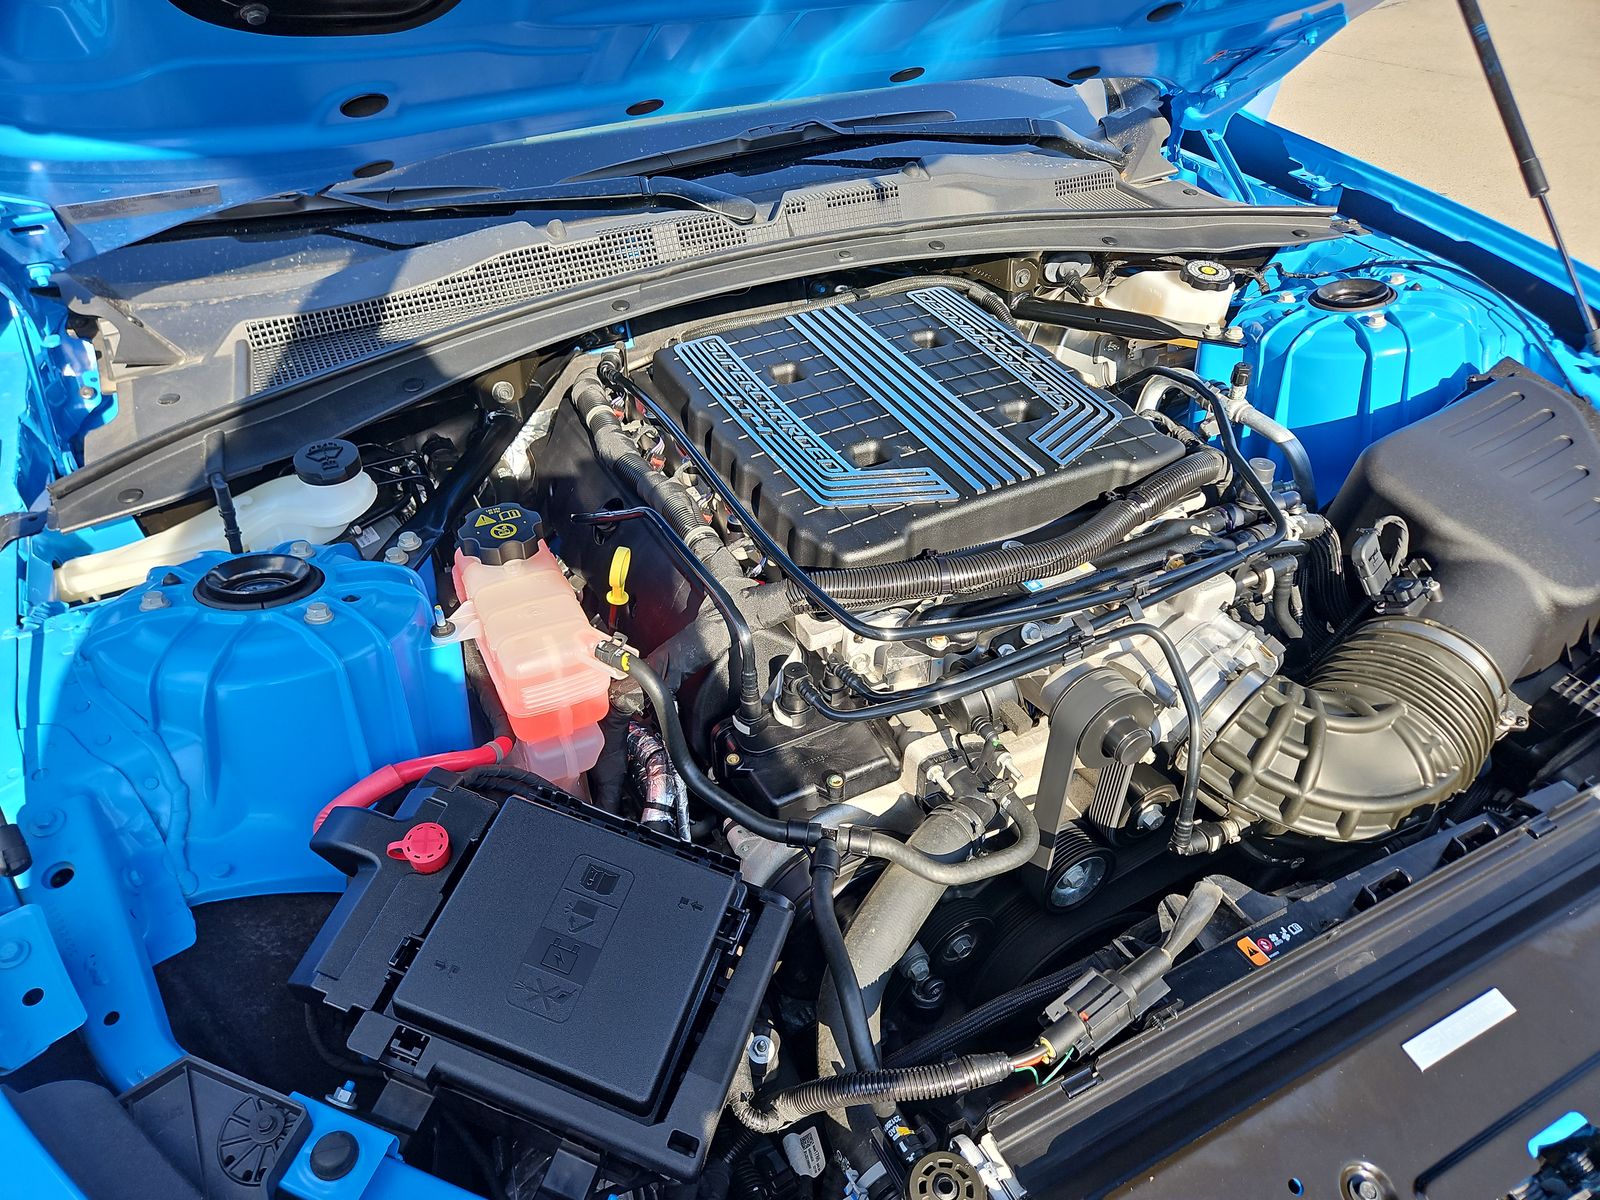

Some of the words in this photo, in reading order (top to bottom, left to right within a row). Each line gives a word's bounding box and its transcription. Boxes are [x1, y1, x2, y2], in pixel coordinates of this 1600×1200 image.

[914, 292, 1069, 408] SUPERCHARGED
[987, 329, 1042, 366] LT4
[703, 340, 843, 474] SUPERCHARGED
[727, 394, 774, 435] LT4
